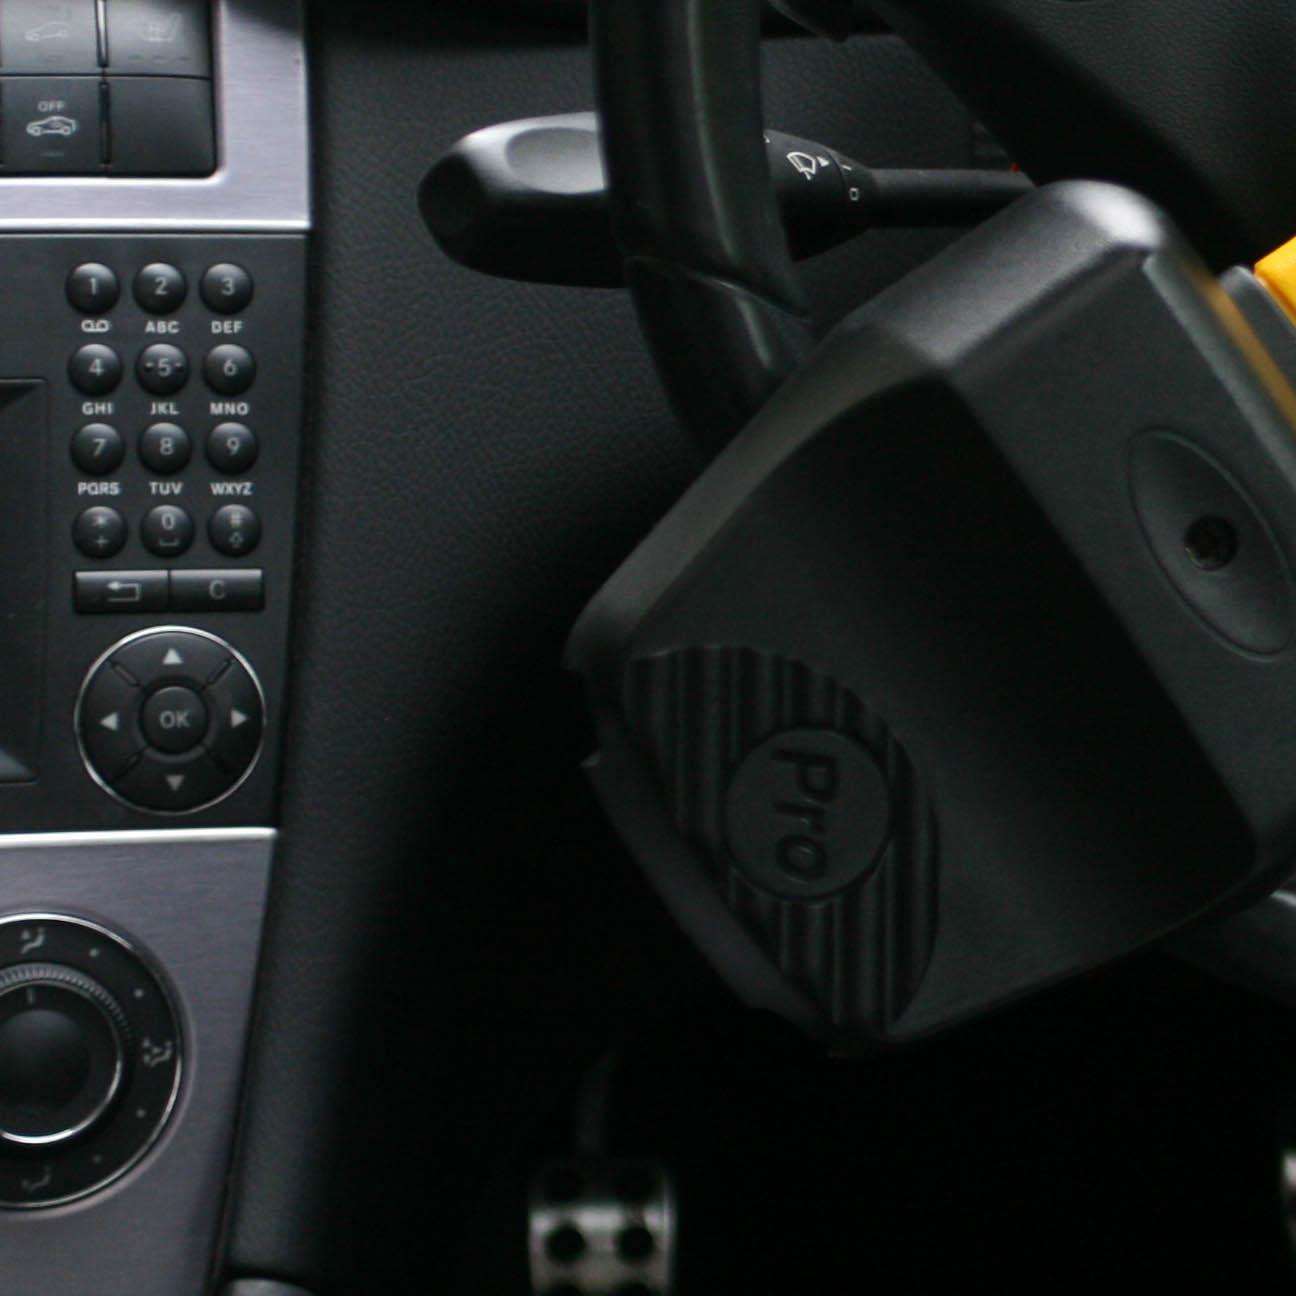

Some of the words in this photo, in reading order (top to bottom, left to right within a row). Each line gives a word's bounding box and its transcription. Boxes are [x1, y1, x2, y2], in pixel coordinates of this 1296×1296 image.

[38, 100, 65, 113] OFF
[88, 277, 98, 297] 1
[154, 277, 168, 296] 2
[221, 277, 235, 296] 3
[144, 320, 180, 334] ABC
[210, 320, 243, 334] DEF
[88, 358, 104, 377] 4
[157, 358, 171, 377] 5
[223, 358, 237, 376] 6
[81, 402, 114, 415] GHI
[149, 402, 180, 415] JKL
[209, 402, 250, 415] MNO
[92, 437, 106, 456] 7
[159, 437, 175, 455] 8
[226, 437, 240, 456] 9
[77, 481, 121, 495] PQRS
[149, 481, 183, 495] TUV
[210, 481, 253, 495] WXYZ
[161, 514, 175, 531] 0
[208, 579, 225, 600] C
[159, 710, 192, 729] OK
[770, 747, 841, 880] Pro
